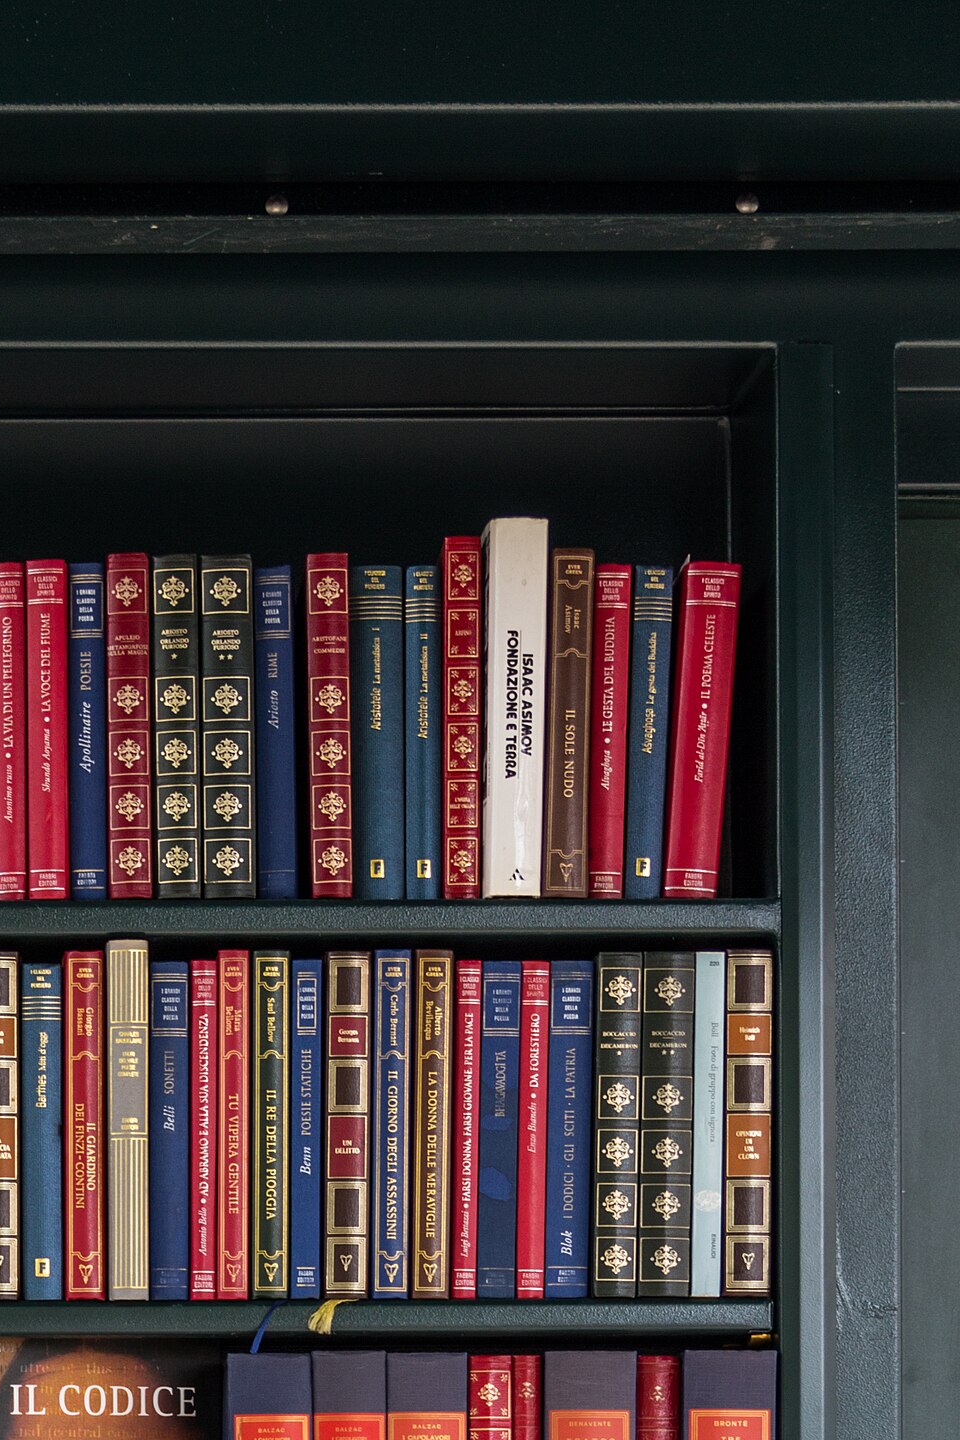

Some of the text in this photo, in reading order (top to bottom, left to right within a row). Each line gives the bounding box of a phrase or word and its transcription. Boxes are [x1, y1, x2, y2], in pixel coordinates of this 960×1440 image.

[2, 617, 13, 748] LA VIA DI UN PELLEGRINO
[79, 652, 94, 772] Apollinaire POESIE
[507, 631, 518, 719] FONDAZIONE
[521, 654, 533, 755] ISAAC ASIMOV
[505, 736, 516, 778] TERRA
[564, 710, 575, 797] IL SOLE NUDO
[267, 998, 275, 1042] Saul Bellow
[163, 1051, 174, 1131] Belli SONETTI
[300, 1050, 311, 1174] Benn POESIE STATICHE
[266, 1090, 276, 1219] IL RE DELLA PIOGGIA
[387, 1071, 398, 1239] IL GIORNO DEGLI ASSASSINI
[561, 1231, 572, 1255] Blok
[10, 1384, 197, 1417] IL CODICE
